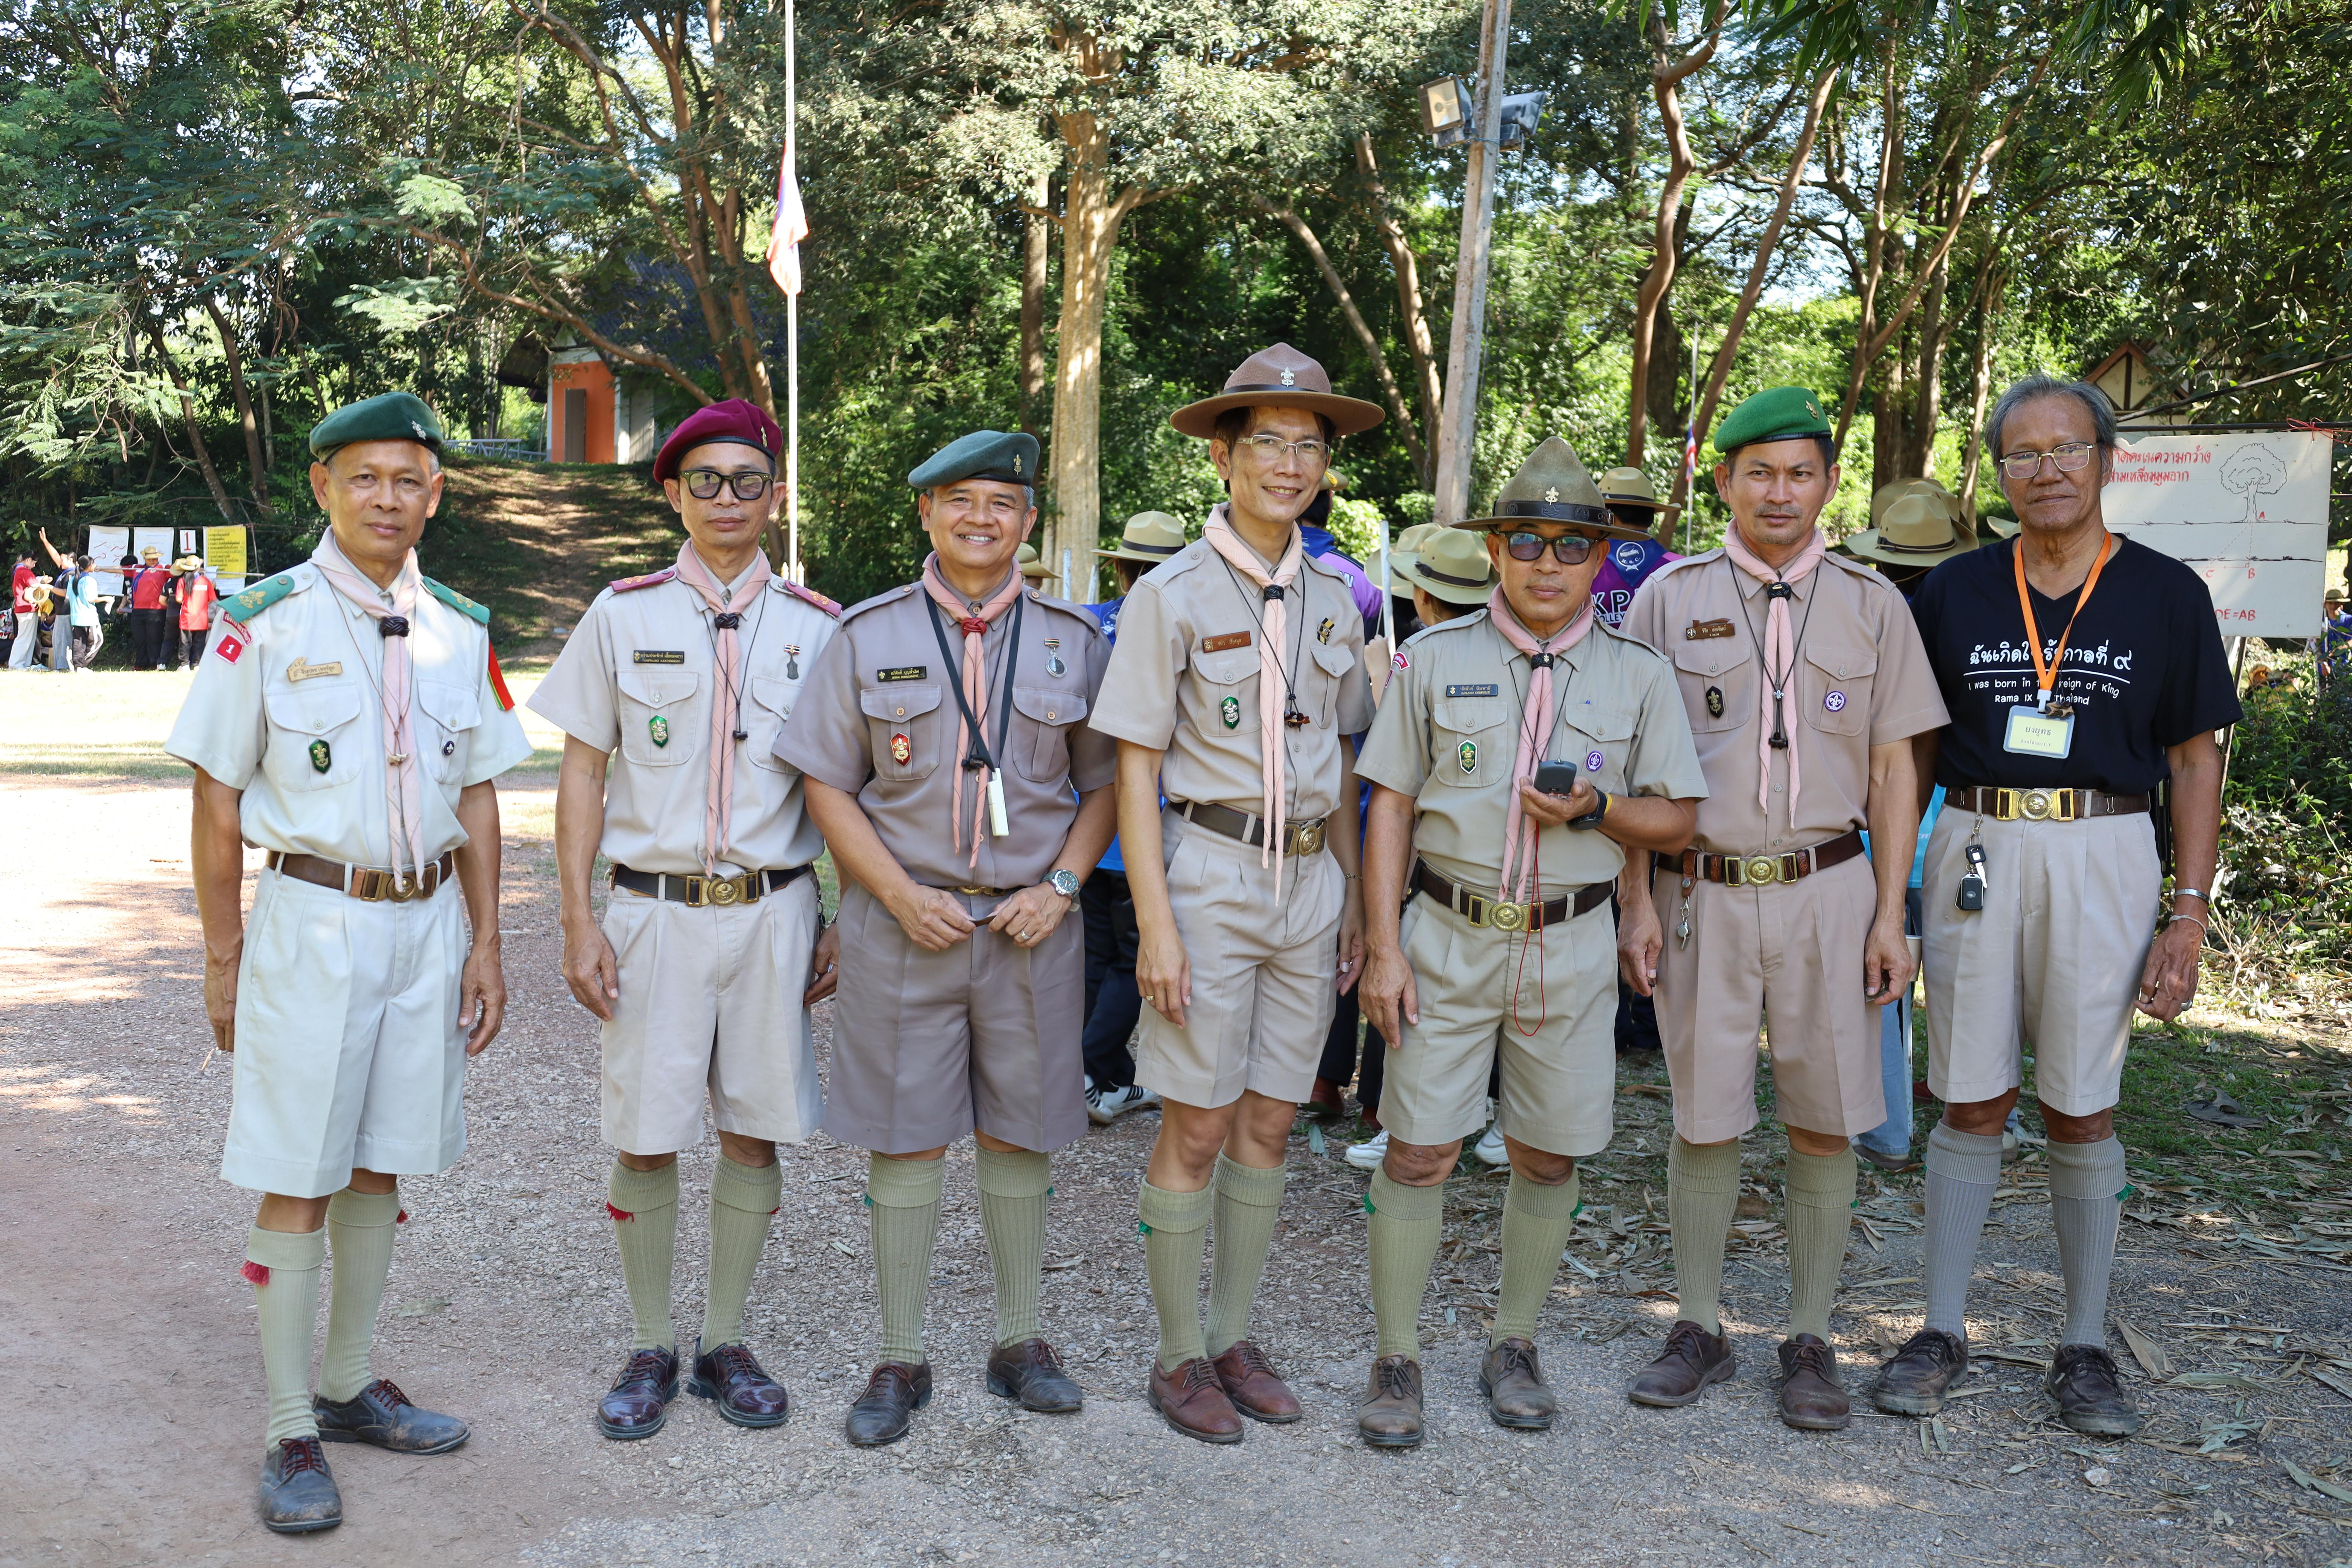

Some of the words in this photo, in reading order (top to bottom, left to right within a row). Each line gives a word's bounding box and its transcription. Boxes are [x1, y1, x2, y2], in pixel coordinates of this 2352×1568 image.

[2113, 445, 2211, 464] าดคะเนความกว้าง
[184, 531, 191, 551] 1
[2205, 570, 2214, 578] C
[2248, 568, 2256, 579] B
[1592, 588, 1640, 616] KP
[1599, 613, 1625, 622] OLLEY
[226, 644, 234, 654] 1
[1970, 639, 2109, 666] ฉันเกิดใรักาลที่
[2114, 650, 2132, 670] ๙
[1974, 681, 1989, 689] was
[1995, 679, 2017, 688] born
[2023, 677, 2031, 687] in
[2059, 677, 2081, 691] reign
[2086, 681, 2097, 690] of
[2054, 693, 2090, 705] Thailand
